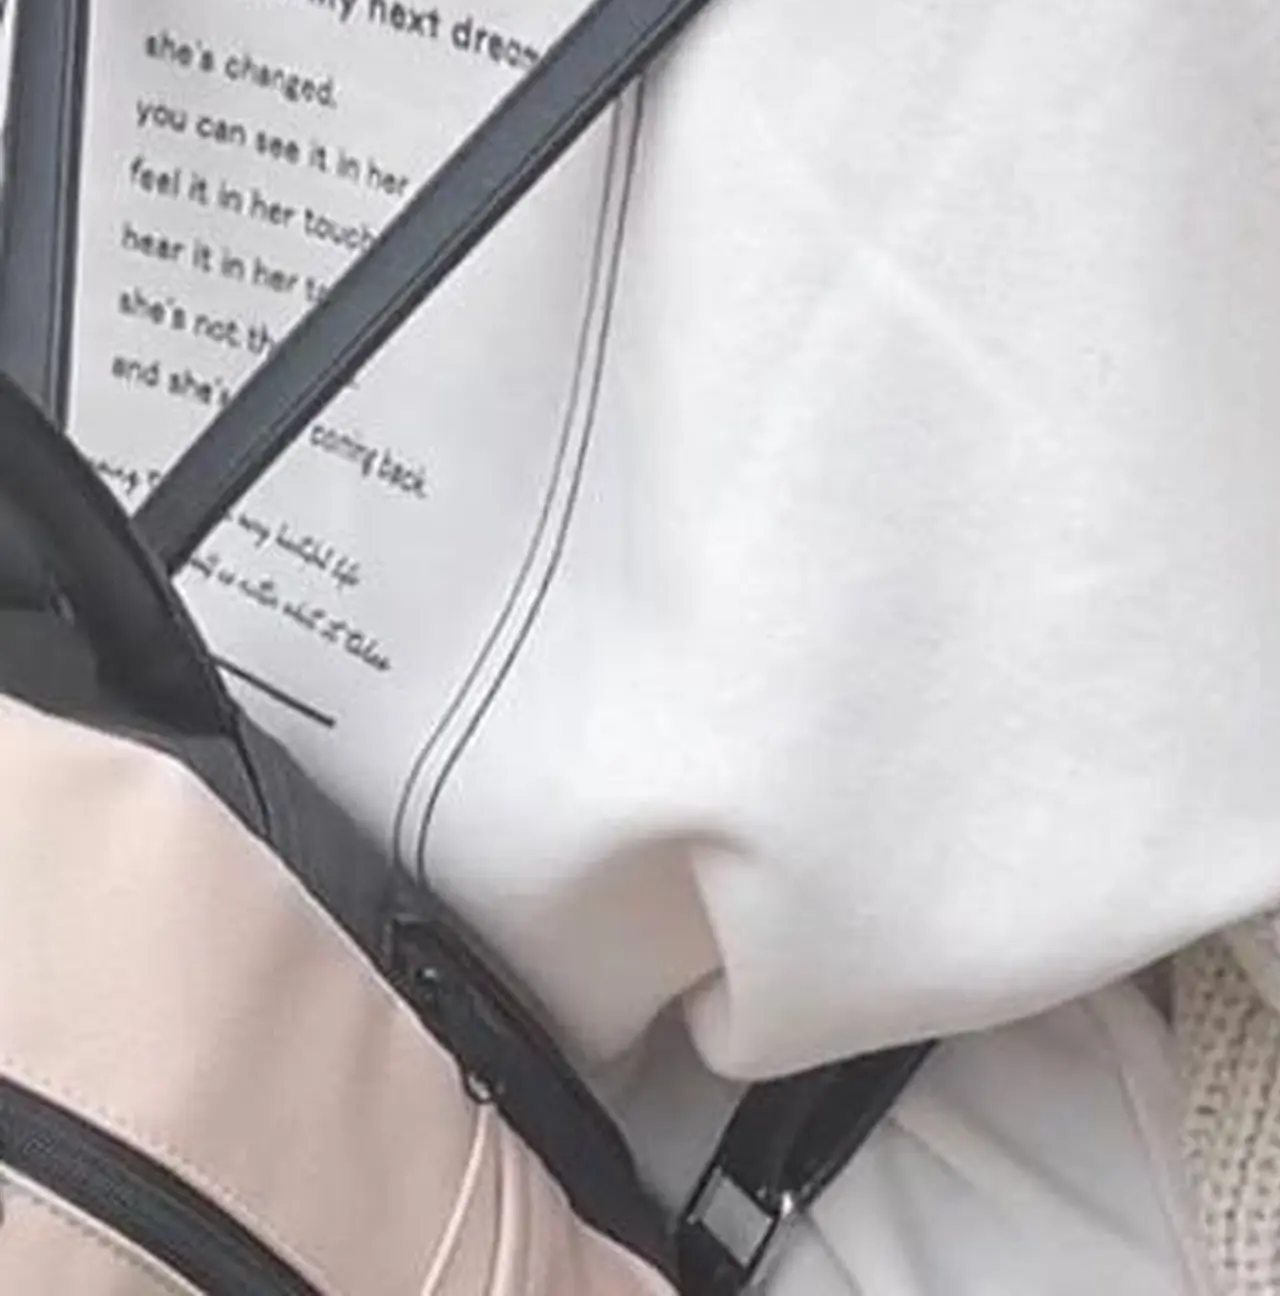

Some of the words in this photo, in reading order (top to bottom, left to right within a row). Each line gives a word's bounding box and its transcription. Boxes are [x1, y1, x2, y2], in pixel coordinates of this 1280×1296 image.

[144, 28, 214, 73] she's
[136, 98, 188, 133] you
[196, 114, 247, 147] can
[256, 129, 300, 165] see
[309, 138, 329, 173] it
[336, 146, 361, 180] in
[367, 157, 408, 198] her
[129, 155, 182, 200] feel
[188, 170, 208, 206] it
[217, 178, 244, 212] in
[250, 187, 295, 228] her
[121, 220, 186, 262] hear
[192, 237, 212, 275] it
[219, 246, 246, 282] in
[252, 251, 301, 294] her
[117, 284, 187, 331] she's
[111, 355, 161, 389] and
